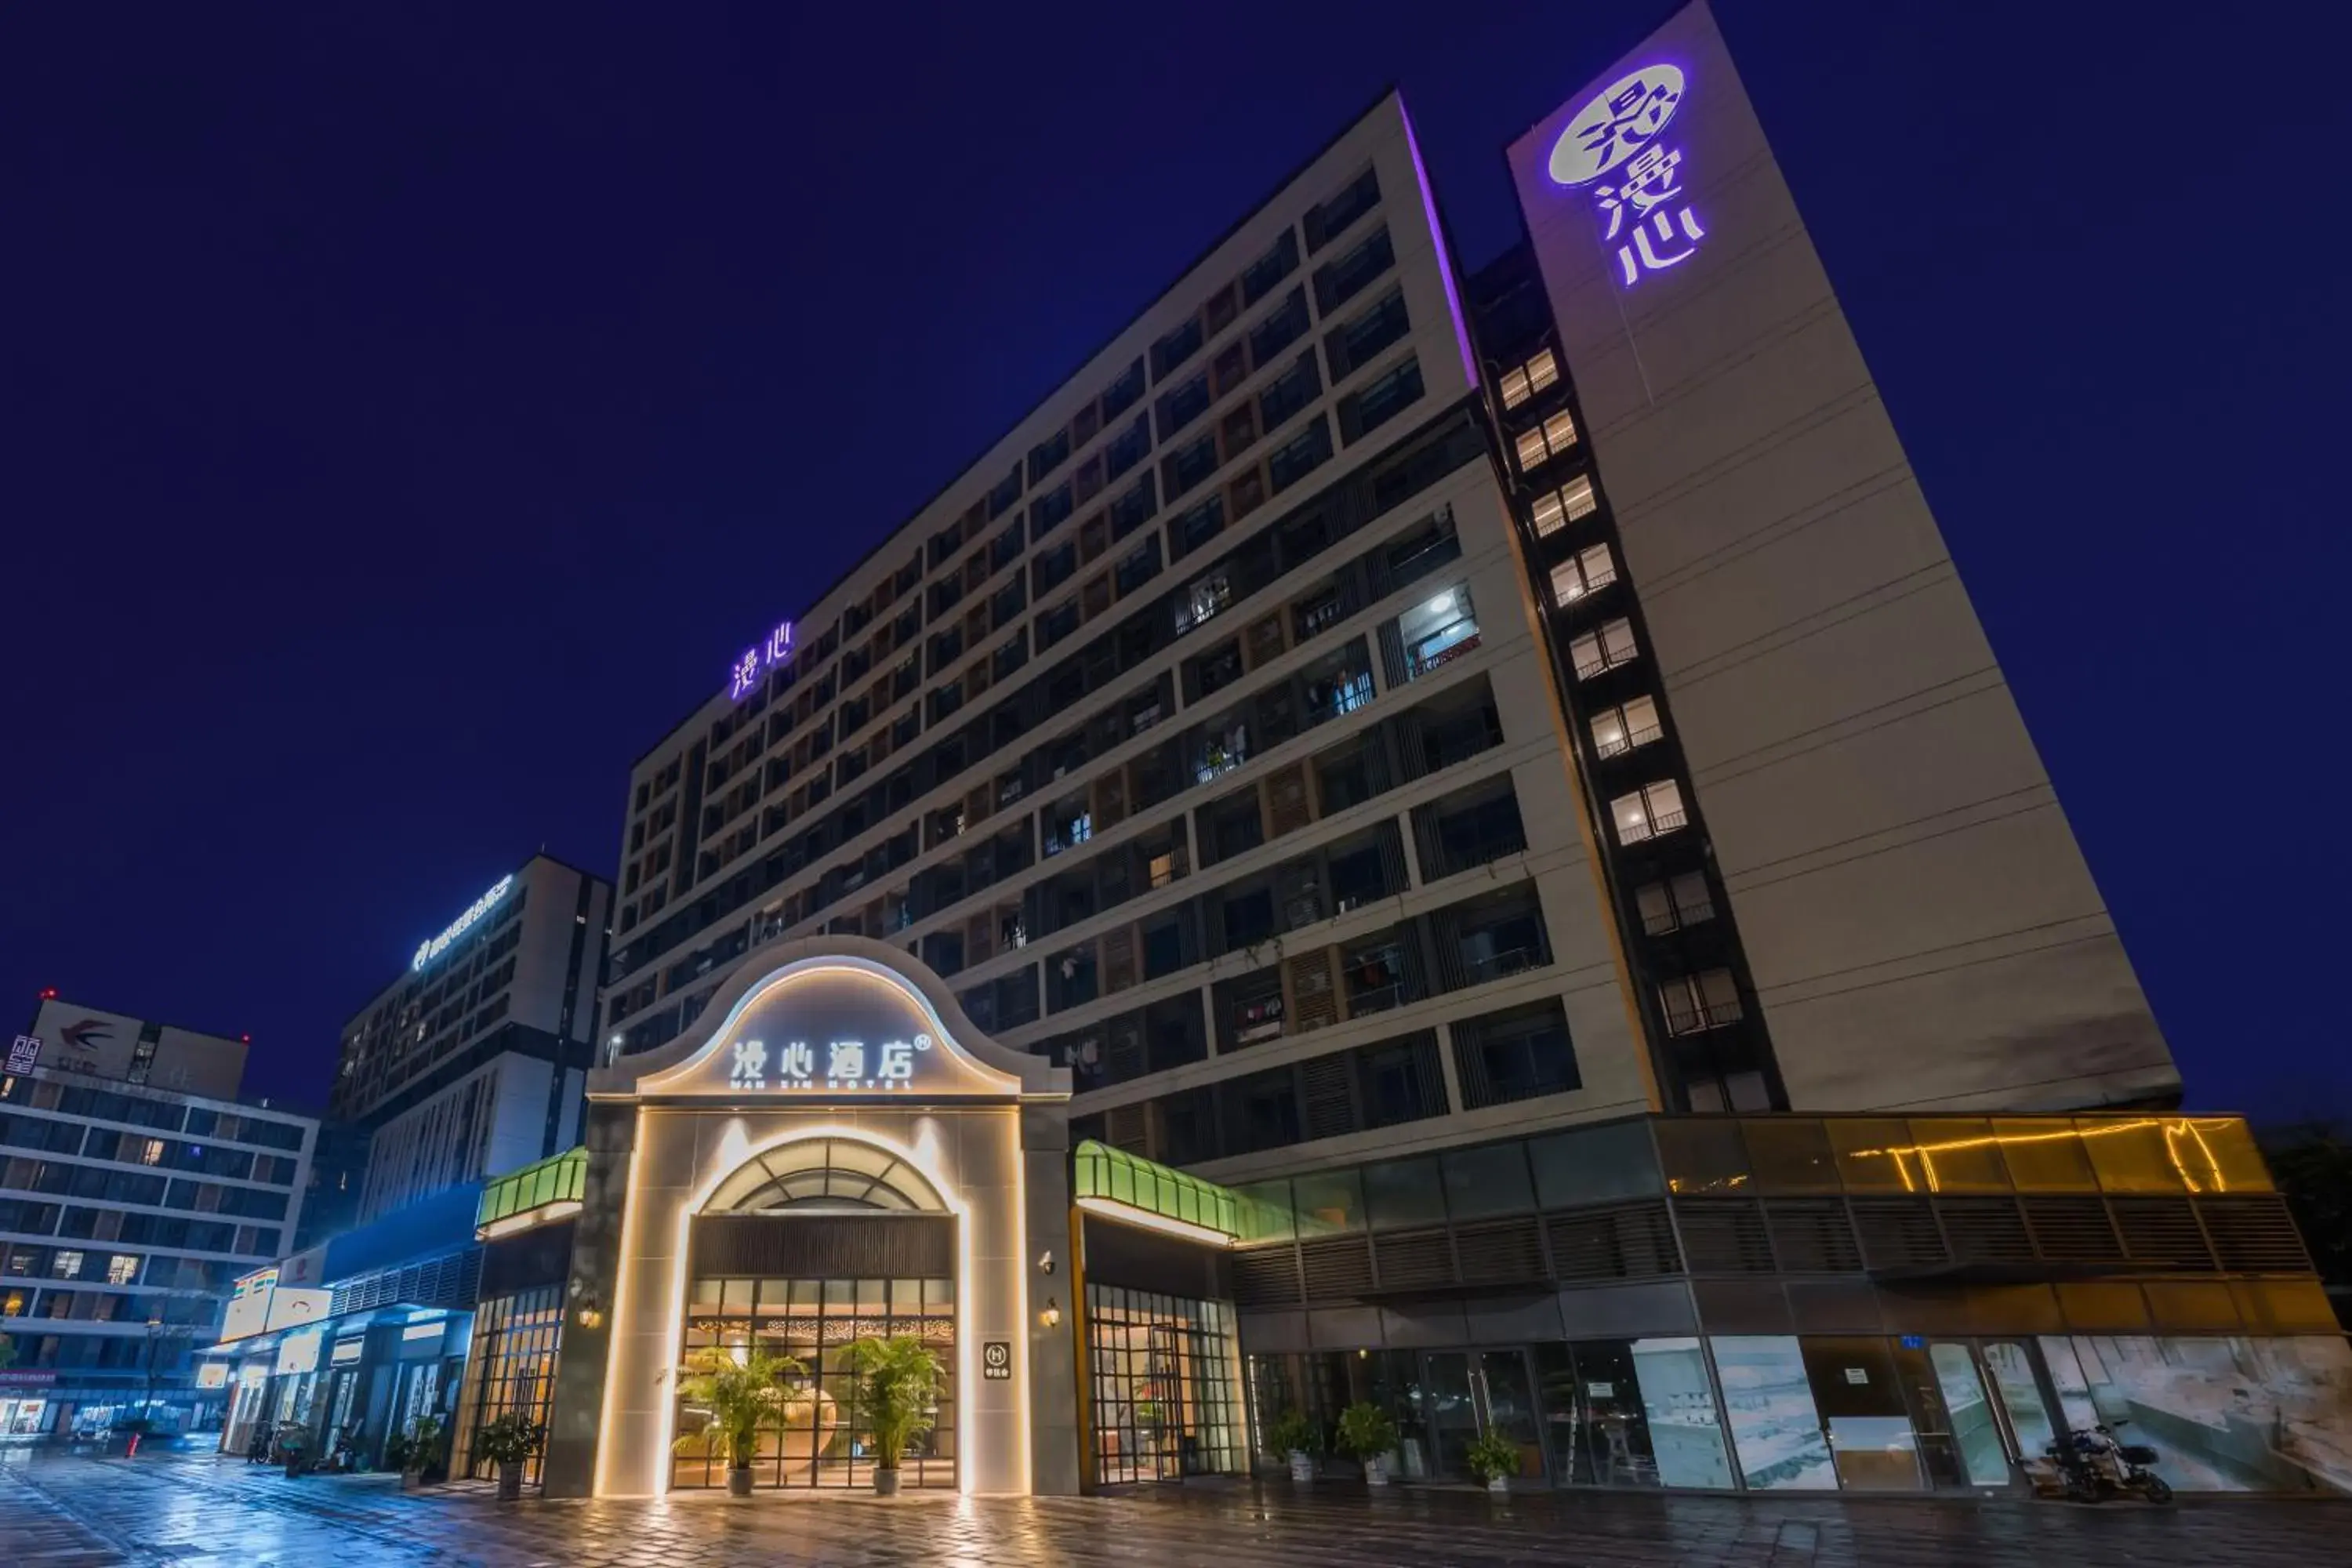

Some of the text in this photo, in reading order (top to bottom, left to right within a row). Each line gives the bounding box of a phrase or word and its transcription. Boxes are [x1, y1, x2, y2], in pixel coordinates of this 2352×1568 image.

[1595, 143, 1705, 287] 漫心
[731, 622, 791, 700] 漫心
[730, 1040, 913, 1079] 漫心酒店
[827, 1080, 913, 1090] HOTEL
